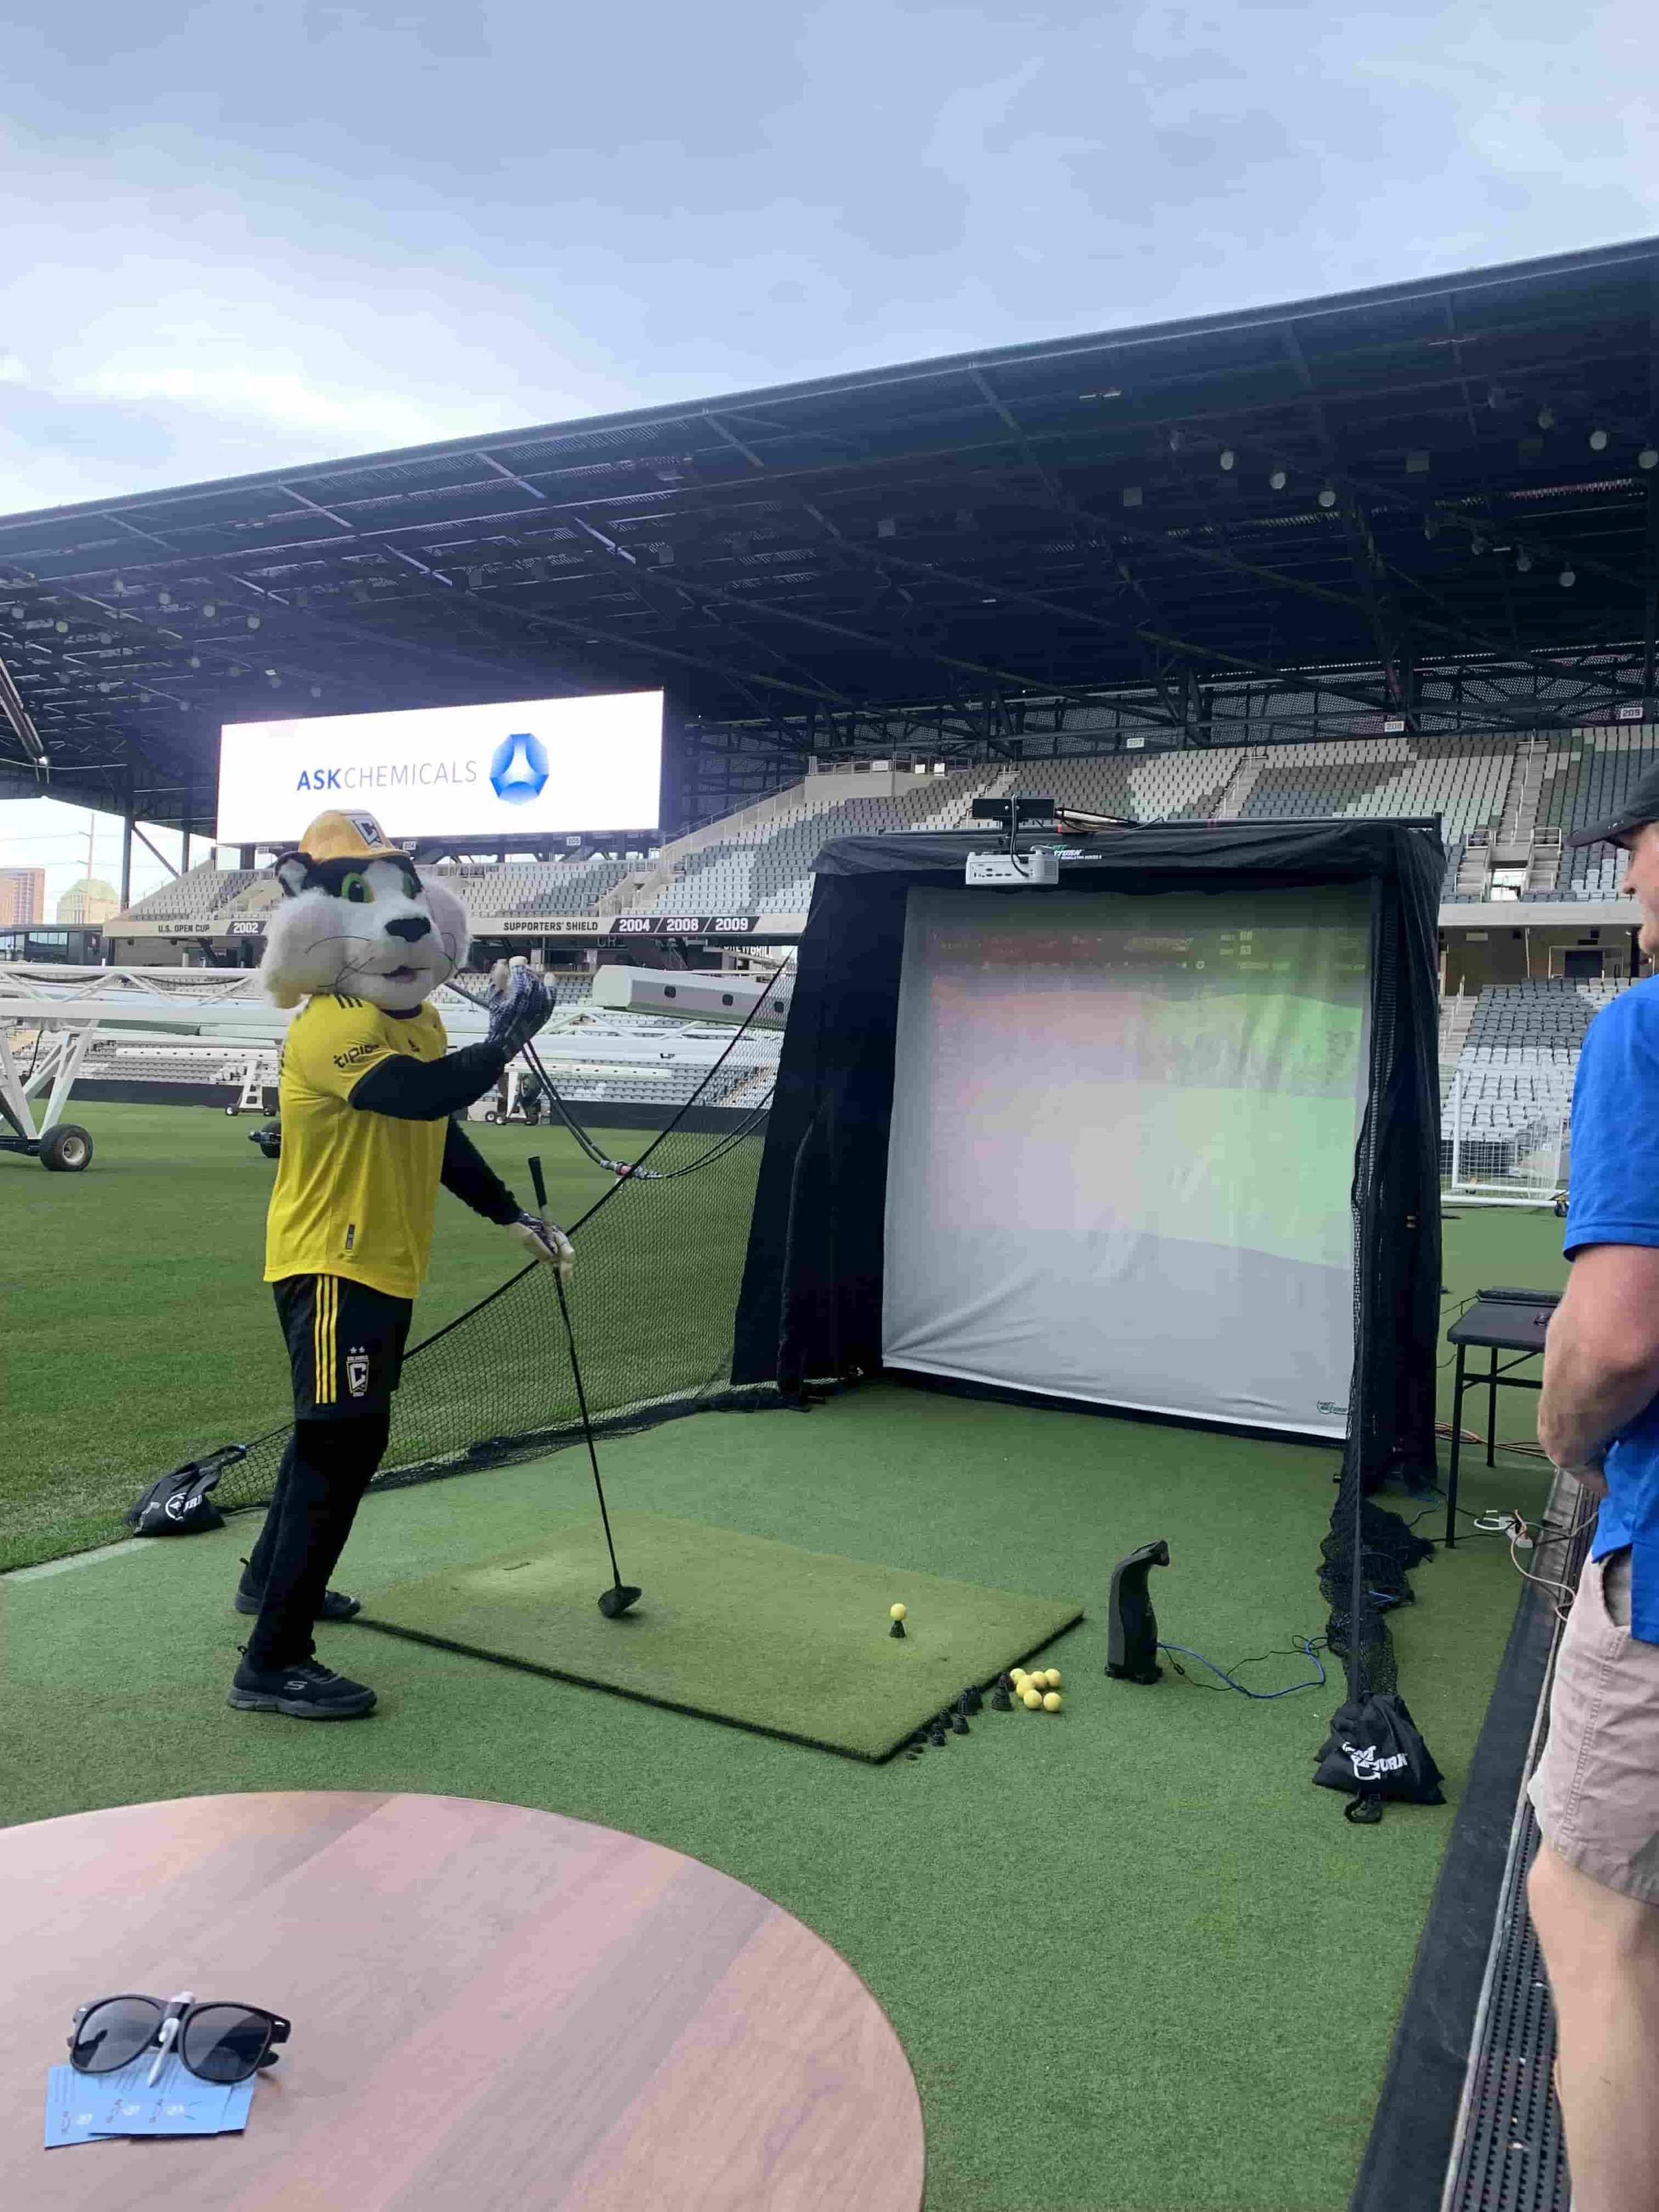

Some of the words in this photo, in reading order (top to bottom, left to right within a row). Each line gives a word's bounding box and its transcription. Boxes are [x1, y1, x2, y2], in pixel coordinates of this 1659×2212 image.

[234, 923, 259, 934] 2002
[504, 922, 563, 930] SUPPORTERS'
[619, 919, 650, 932] 2004
[666, 918, 699, 931] 2008
[715, 918, 749, 930] 2009
